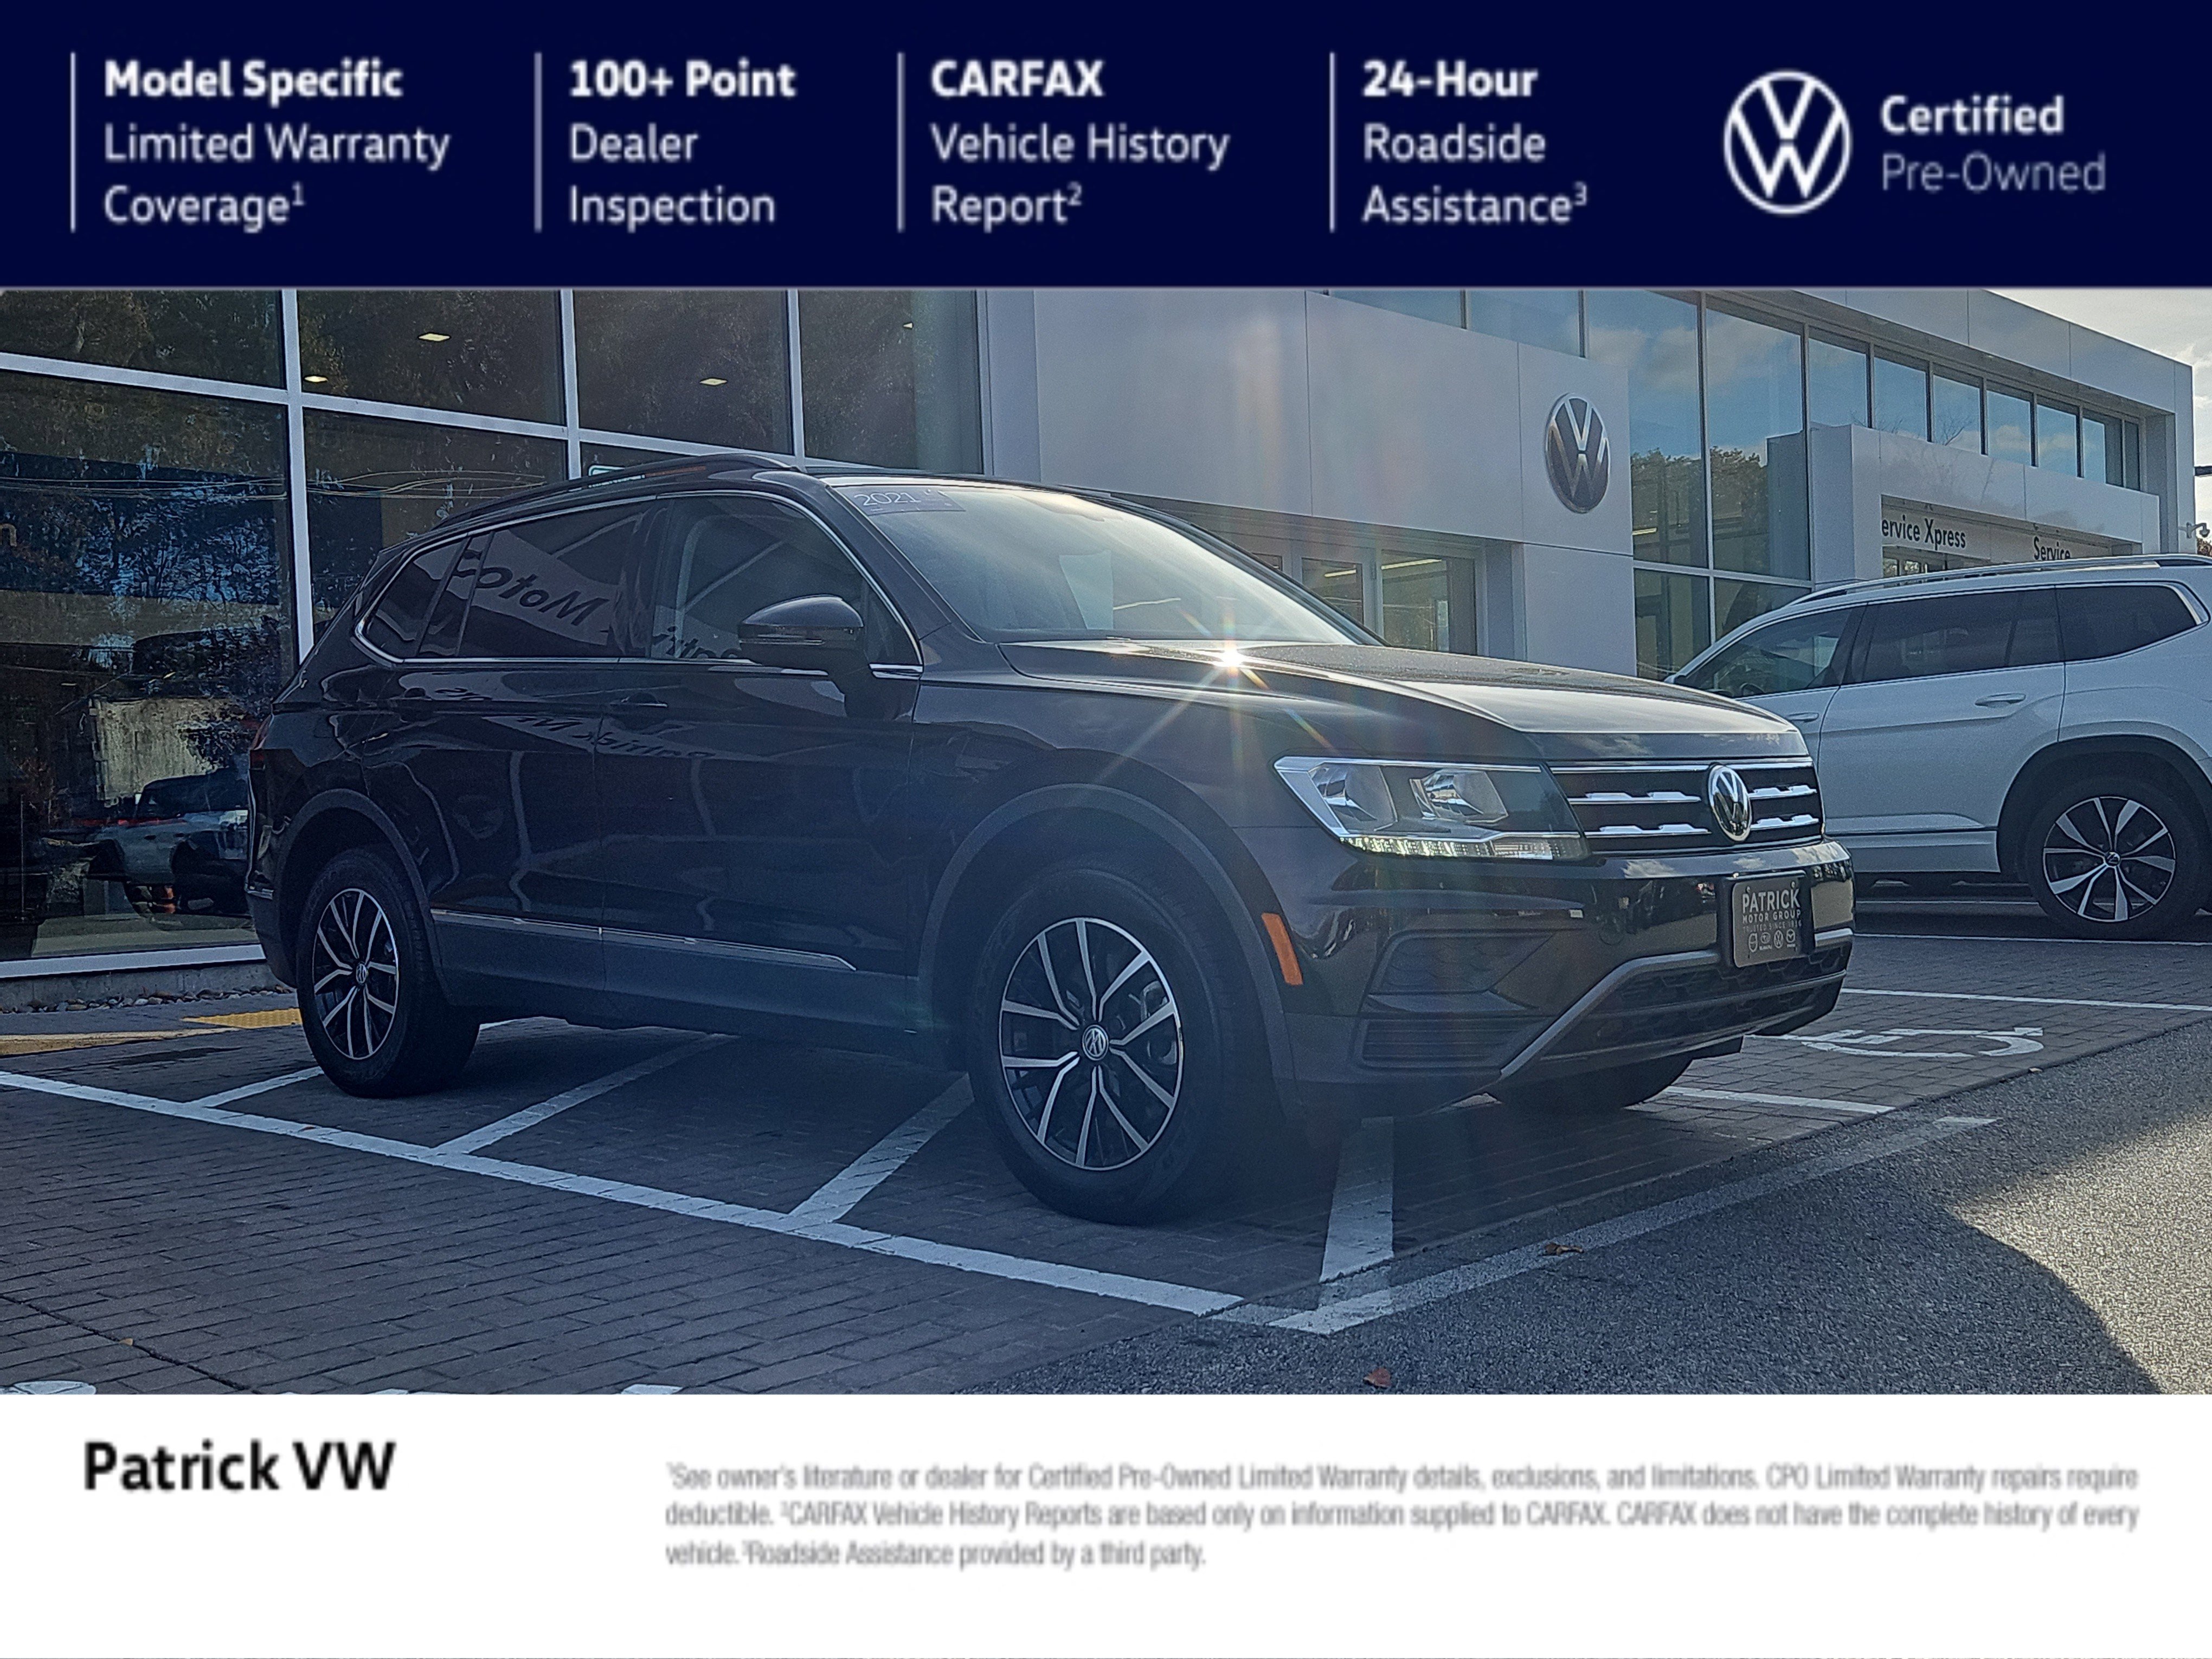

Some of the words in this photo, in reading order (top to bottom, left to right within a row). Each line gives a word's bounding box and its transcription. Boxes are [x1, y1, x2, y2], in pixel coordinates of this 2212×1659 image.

[853, 491, 922, 506] 2021
[1881, 514, 1920, 542] ervice
[1925, 518, 1966, 551] Xpress
[2033, 536, 2070, 561] Service
[1742, 888, 1801, 914] PATRICK
[1742, 912, 1769, 924] MOTOR
[1772, 909, 1801, 921] GROUP
